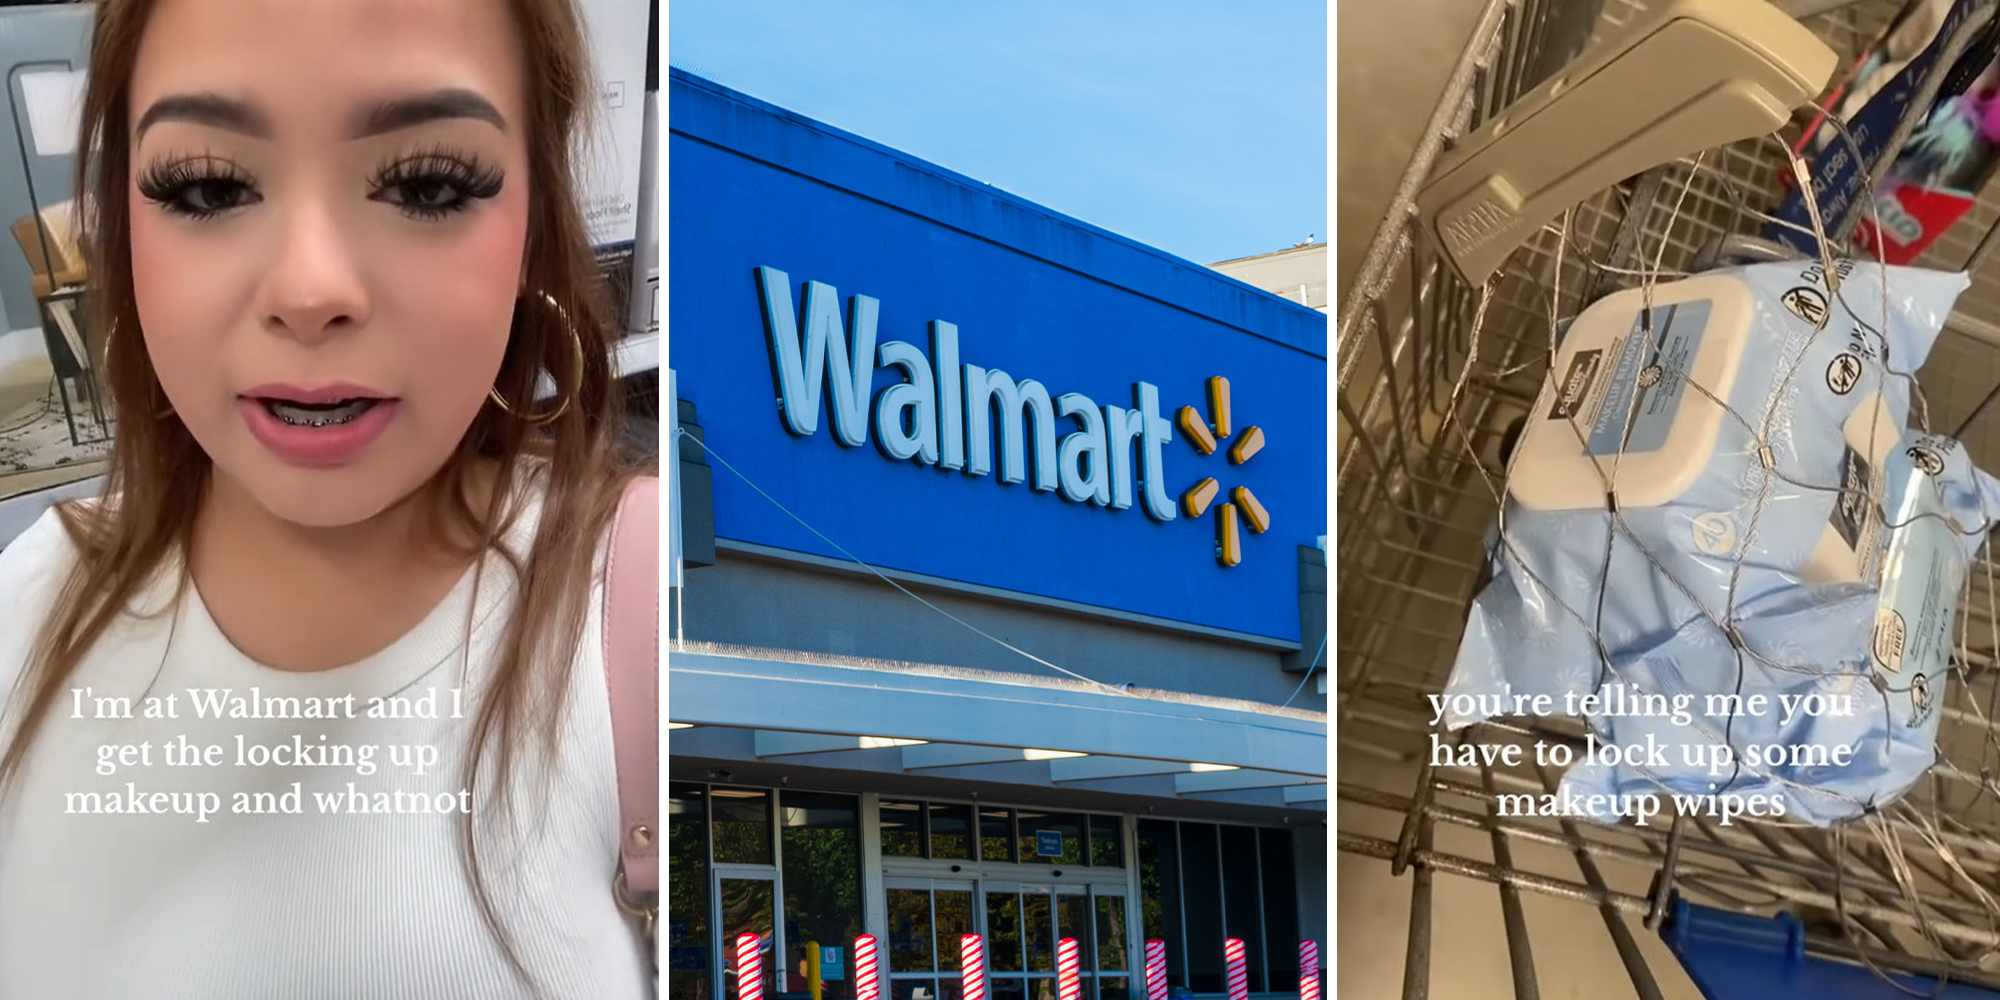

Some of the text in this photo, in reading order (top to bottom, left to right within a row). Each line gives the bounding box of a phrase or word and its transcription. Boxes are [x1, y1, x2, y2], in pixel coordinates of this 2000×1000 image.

[1445, 199, 1510, 247] ALPHA
[754, 264, 1177, 522] Walmart
[1593, 381, 1621, 434] MAKEUP
[1703, 518, 1727, 549] 40
